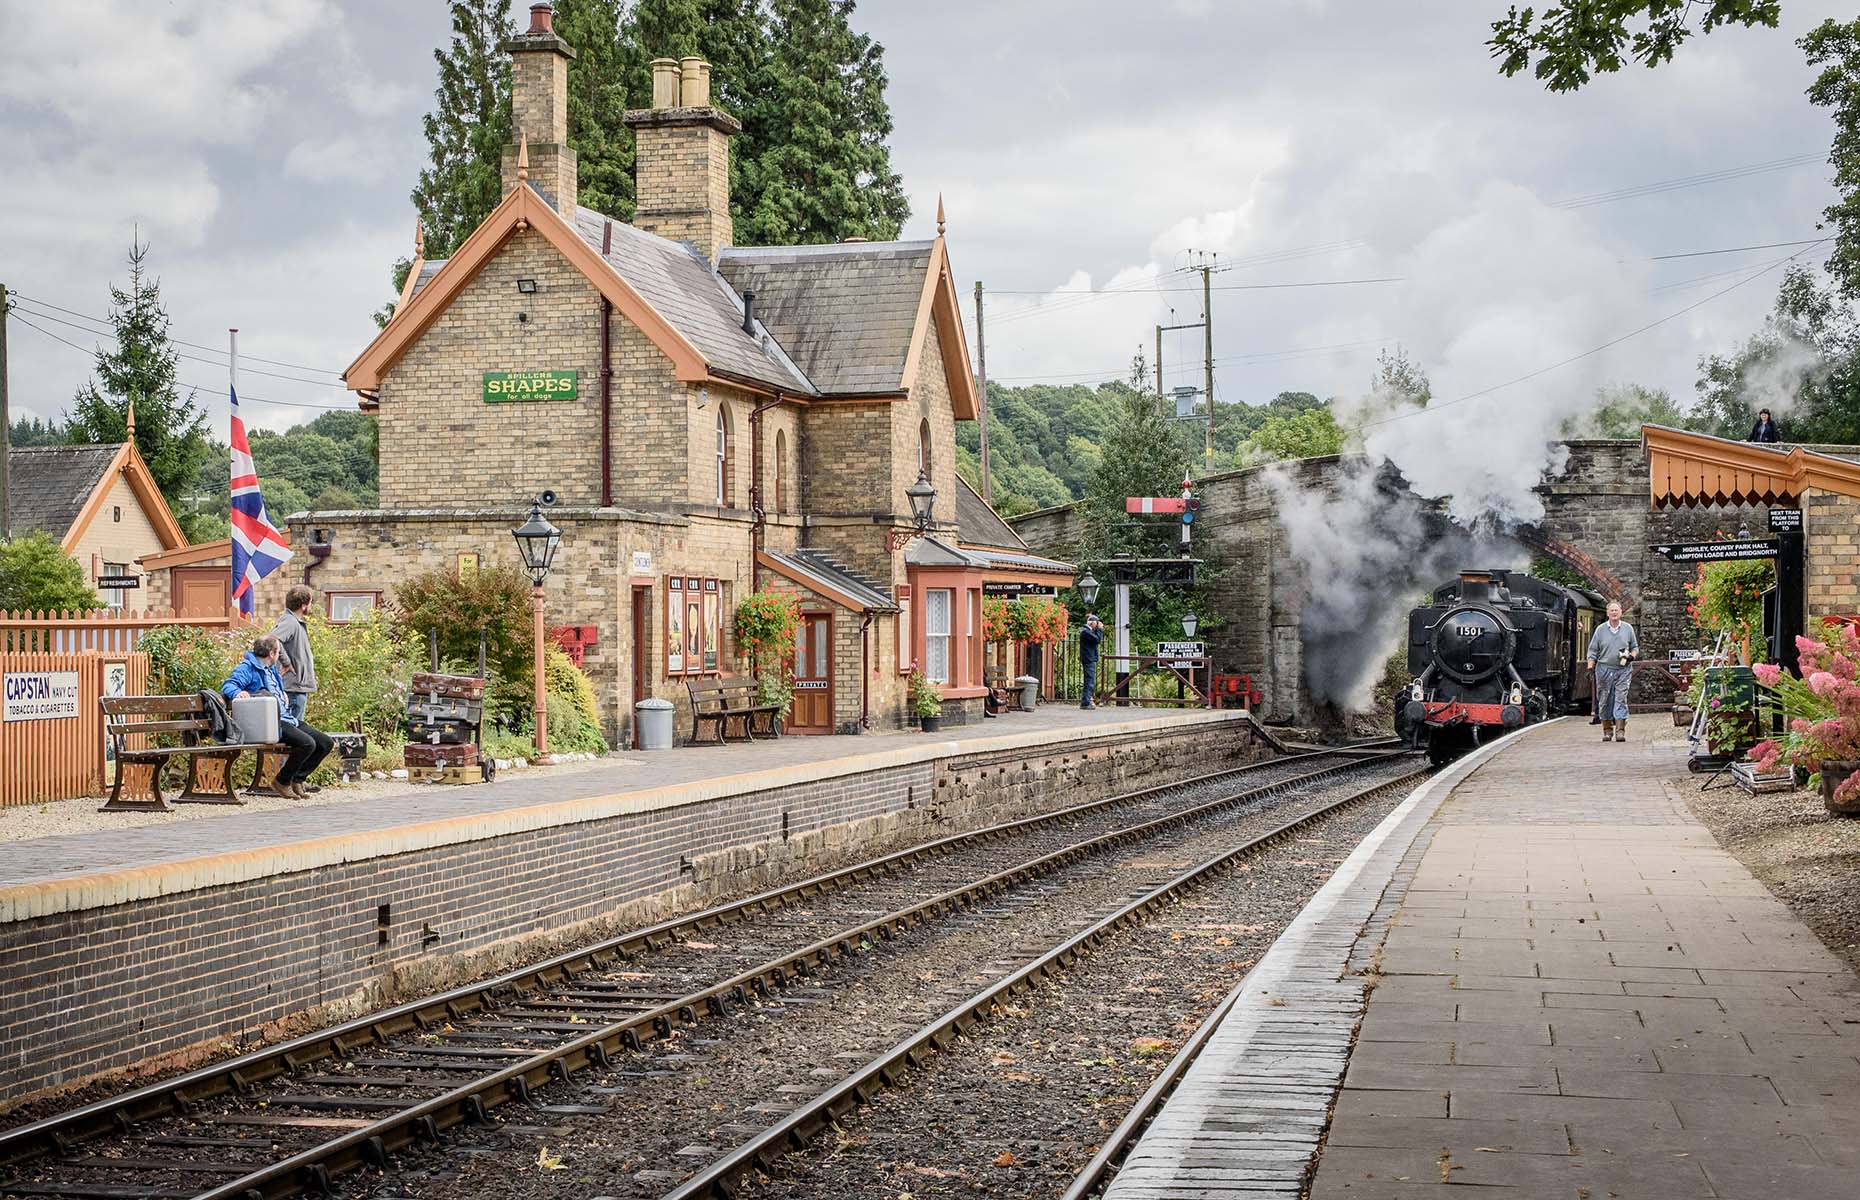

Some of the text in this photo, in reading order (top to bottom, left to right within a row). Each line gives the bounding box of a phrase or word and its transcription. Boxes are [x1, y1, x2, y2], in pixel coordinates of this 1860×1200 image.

[488, 379, 572, 393] SHAPES
[1460, 627, 1481, 636] 1501
[7, 677, 50, 701] CAPSTAN
[52, 687, 66, 698] NAVY
[9, 702, 74, 715] TOBACCO & CIGARETTES
